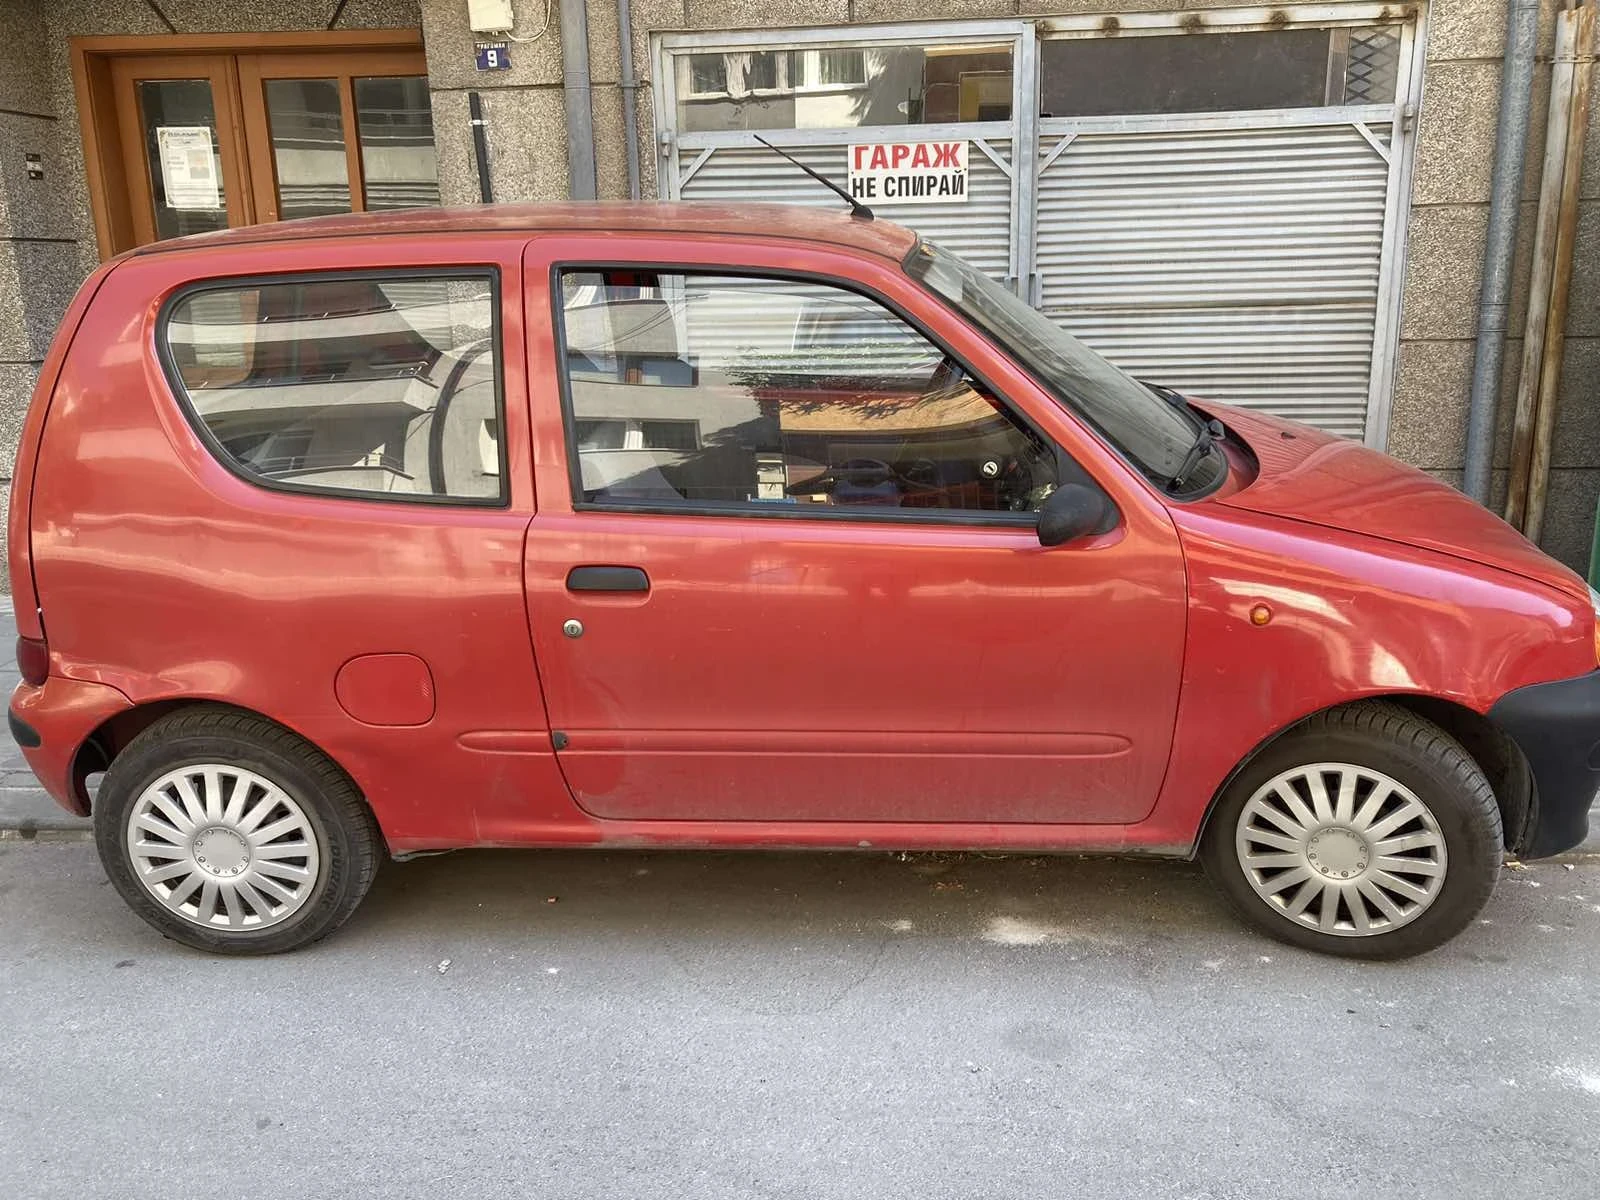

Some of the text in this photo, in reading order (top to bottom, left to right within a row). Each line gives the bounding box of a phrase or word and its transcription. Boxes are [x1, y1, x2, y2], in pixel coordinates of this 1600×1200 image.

[487, 50, 498, 67] 9
[854, 143, 961, 170] ГАРАЖ
[852, 170, 965, 198] НЕ СПИРАЙ
